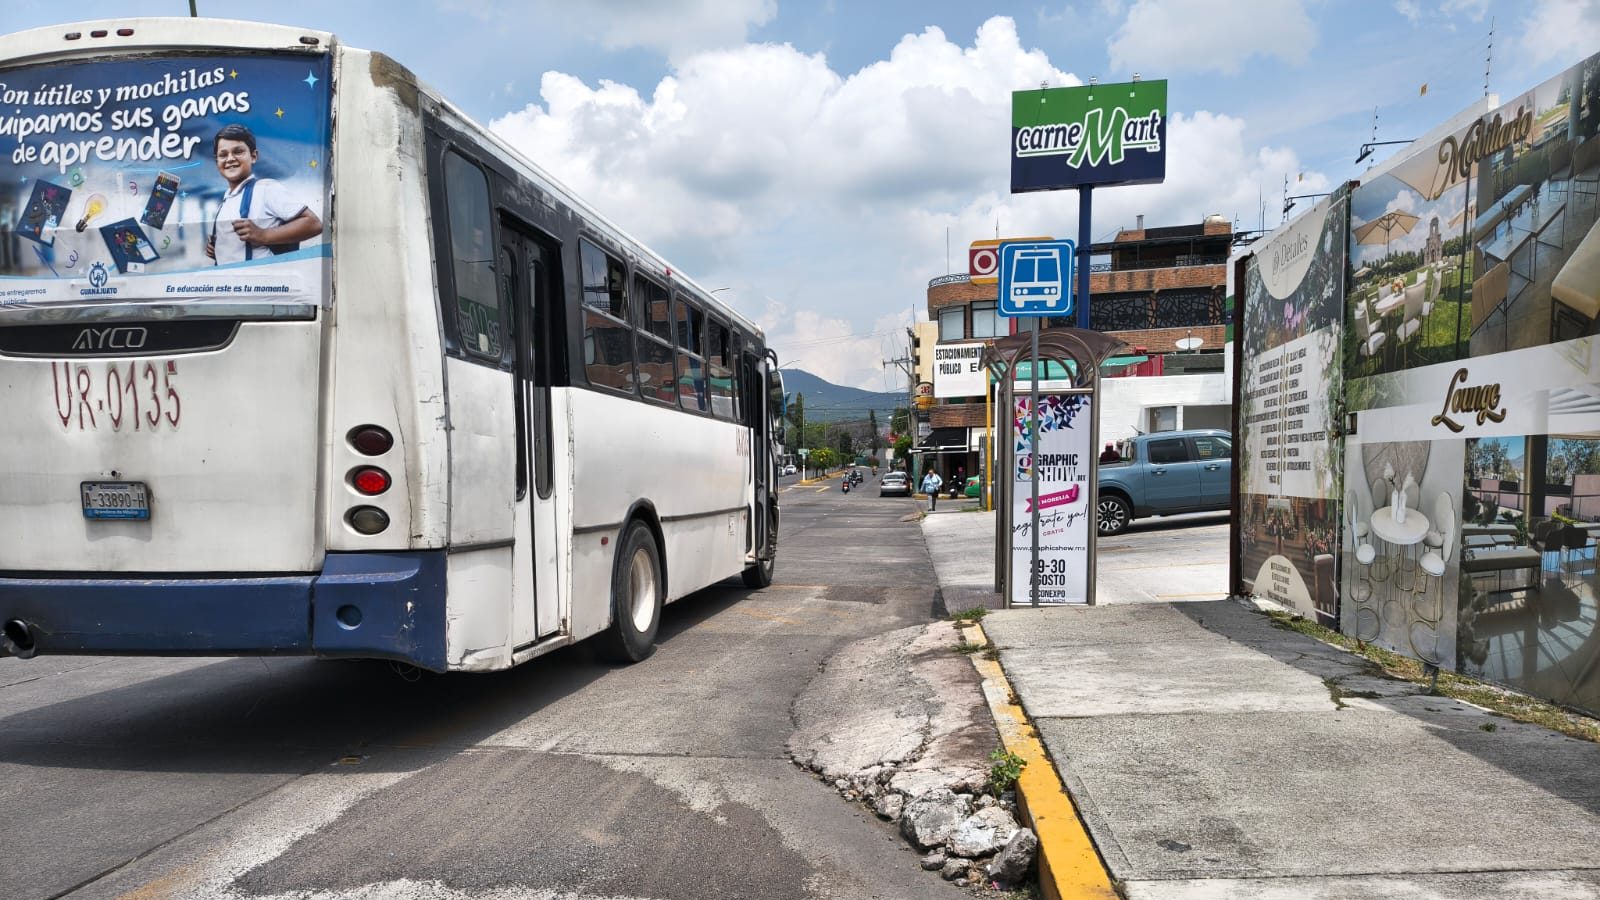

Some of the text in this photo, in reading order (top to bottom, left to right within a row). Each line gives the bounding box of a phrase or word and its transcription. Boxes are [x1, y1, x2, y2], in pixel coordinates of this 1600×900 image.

[33, 83, 91, 106] útiles
[94, 87, 111, 110] y
[116, 67, 225, 101] mochilas
[111, 106, 154, 131] sus
[162, 90, 250, 131] ganas
[12, 128, 201, 173] de aprender
[80, 287, 117, 295] GUANAJUATO
[177, 284, 213, 292] educación
[216, 284, 232, 292] este
[244, 284, 252, 292] tu
[254, 284, 290, 292] momento
[72, 327, 147, 349] AYCO
[936, 347, 983, 360] ESTACIONAMIENT
[939, 361, 962, 374] PÚBLICO
[1431, 367, 1506, 433] Lounge
[1038, 453, 1078, 466] GRAPHIC
